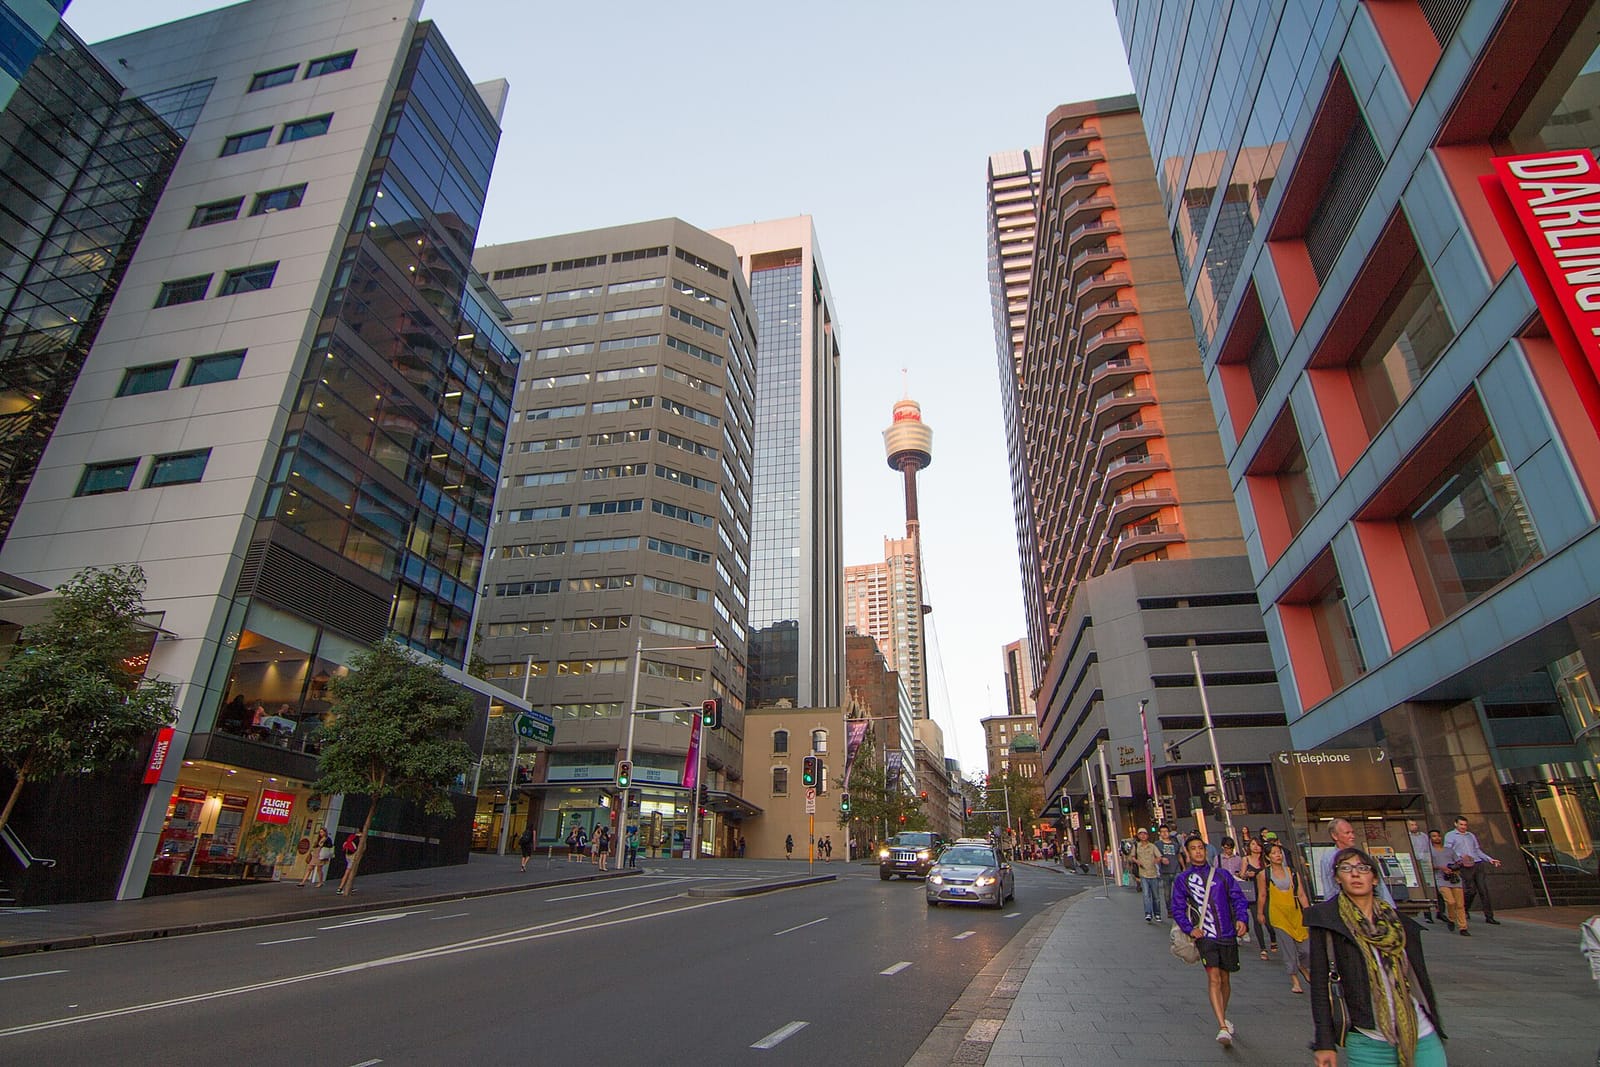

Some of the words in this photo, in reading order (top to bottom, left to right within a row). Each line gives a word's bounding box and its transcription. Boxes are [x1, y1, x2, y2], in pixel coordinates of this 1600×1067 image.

[151, 741, 164, 770] FLIGHT
[155, 740, 169, 770] CENTRE
[1117, 744, 1135, 755] The
[1119, 752, 1156, 767] Berkely
[1293, 752, 1351, 765] Telephone
[263, 797, 292, 809] FLIGHT
[260, 806, 290, 817] CENTRE
